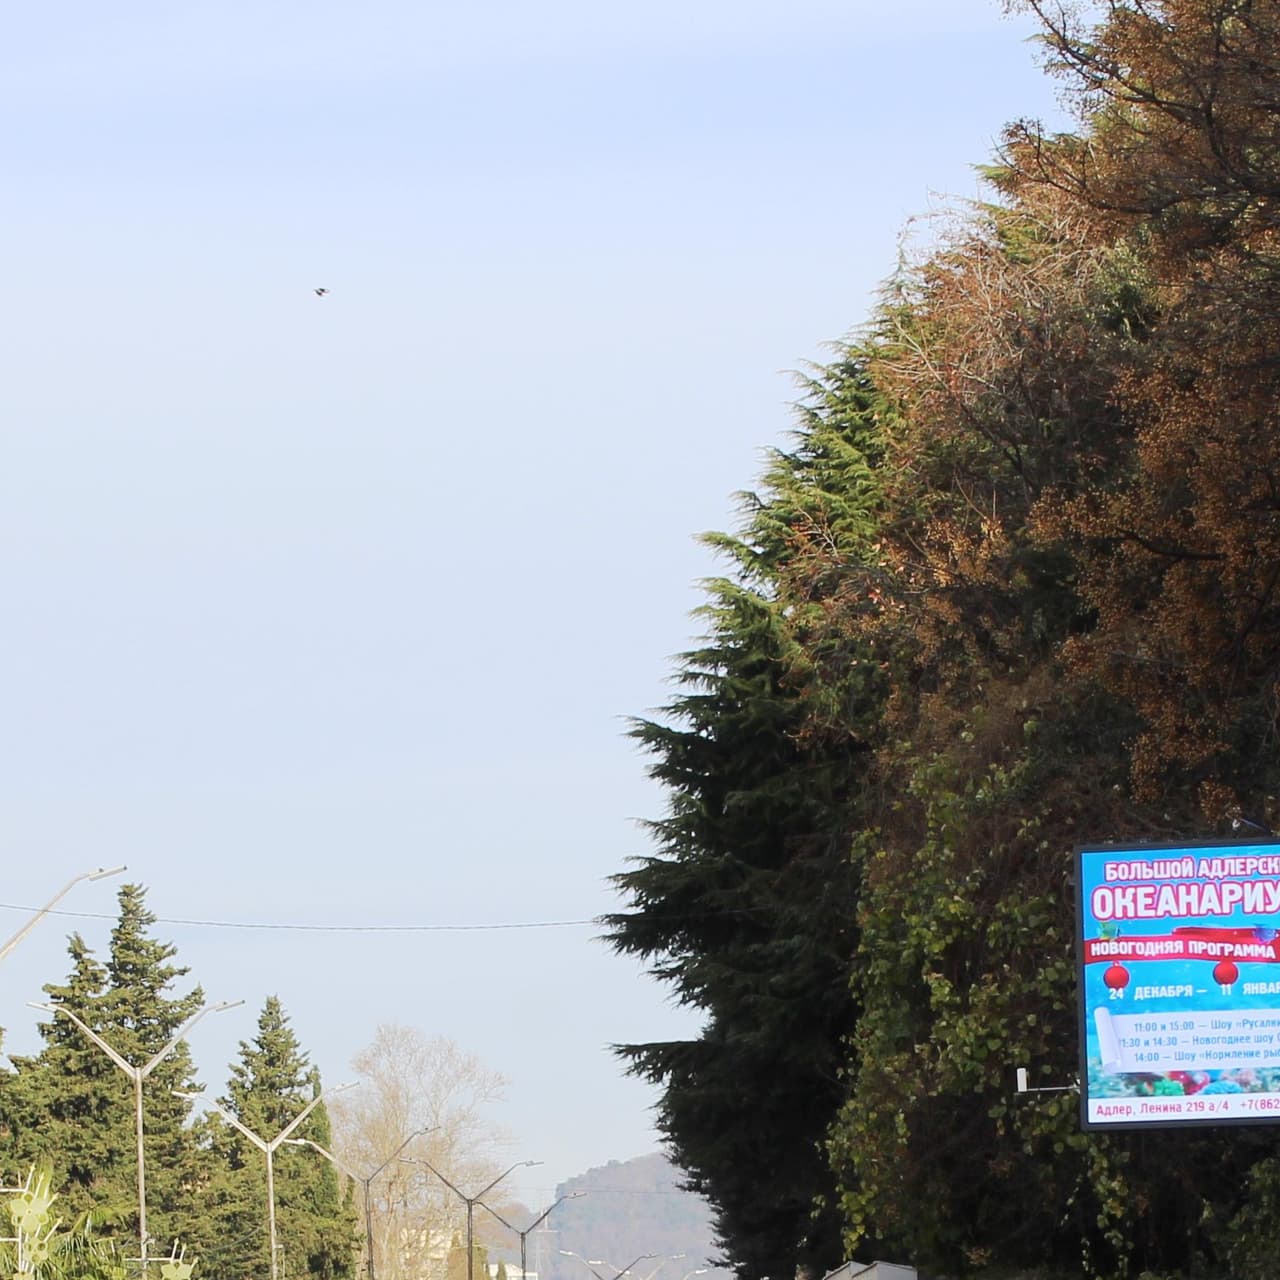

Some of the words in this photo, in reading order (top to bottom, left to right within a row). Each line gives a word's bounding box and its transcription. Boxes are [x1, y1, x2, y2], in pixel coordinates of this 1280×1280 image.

[1105, 858, 1194, 881] БОЛЬШОЙ
[1091, 940, 1183, 957] НОВОГОДНЯЯ
[1188, 940, 1276, 959] ПРОГРАММА
[1109, 987, 1124, 1000] 24
[1134, 984, 1193, 1000] ДЕКАБРЯ
[1134, 1022, 1158, 1032] 11:00
[1170, 1020, 1195, 1031] 15:00
[1211, 1019, 1232, 1031] Шоу
[1192, 1035, 1252, 1046] Новогоднее
[1254, 1035, 1274, 1045] шоу
[1135, 1052, 1160, 1062] 14:00
[1174, 1050, 1197, 1062] Шоу
[1096, 1103, 1137, 1117] Адлер,
[1140, 1102, 1182, 1114] Ленина
[1186, 1101, 1205, 1113] 219
